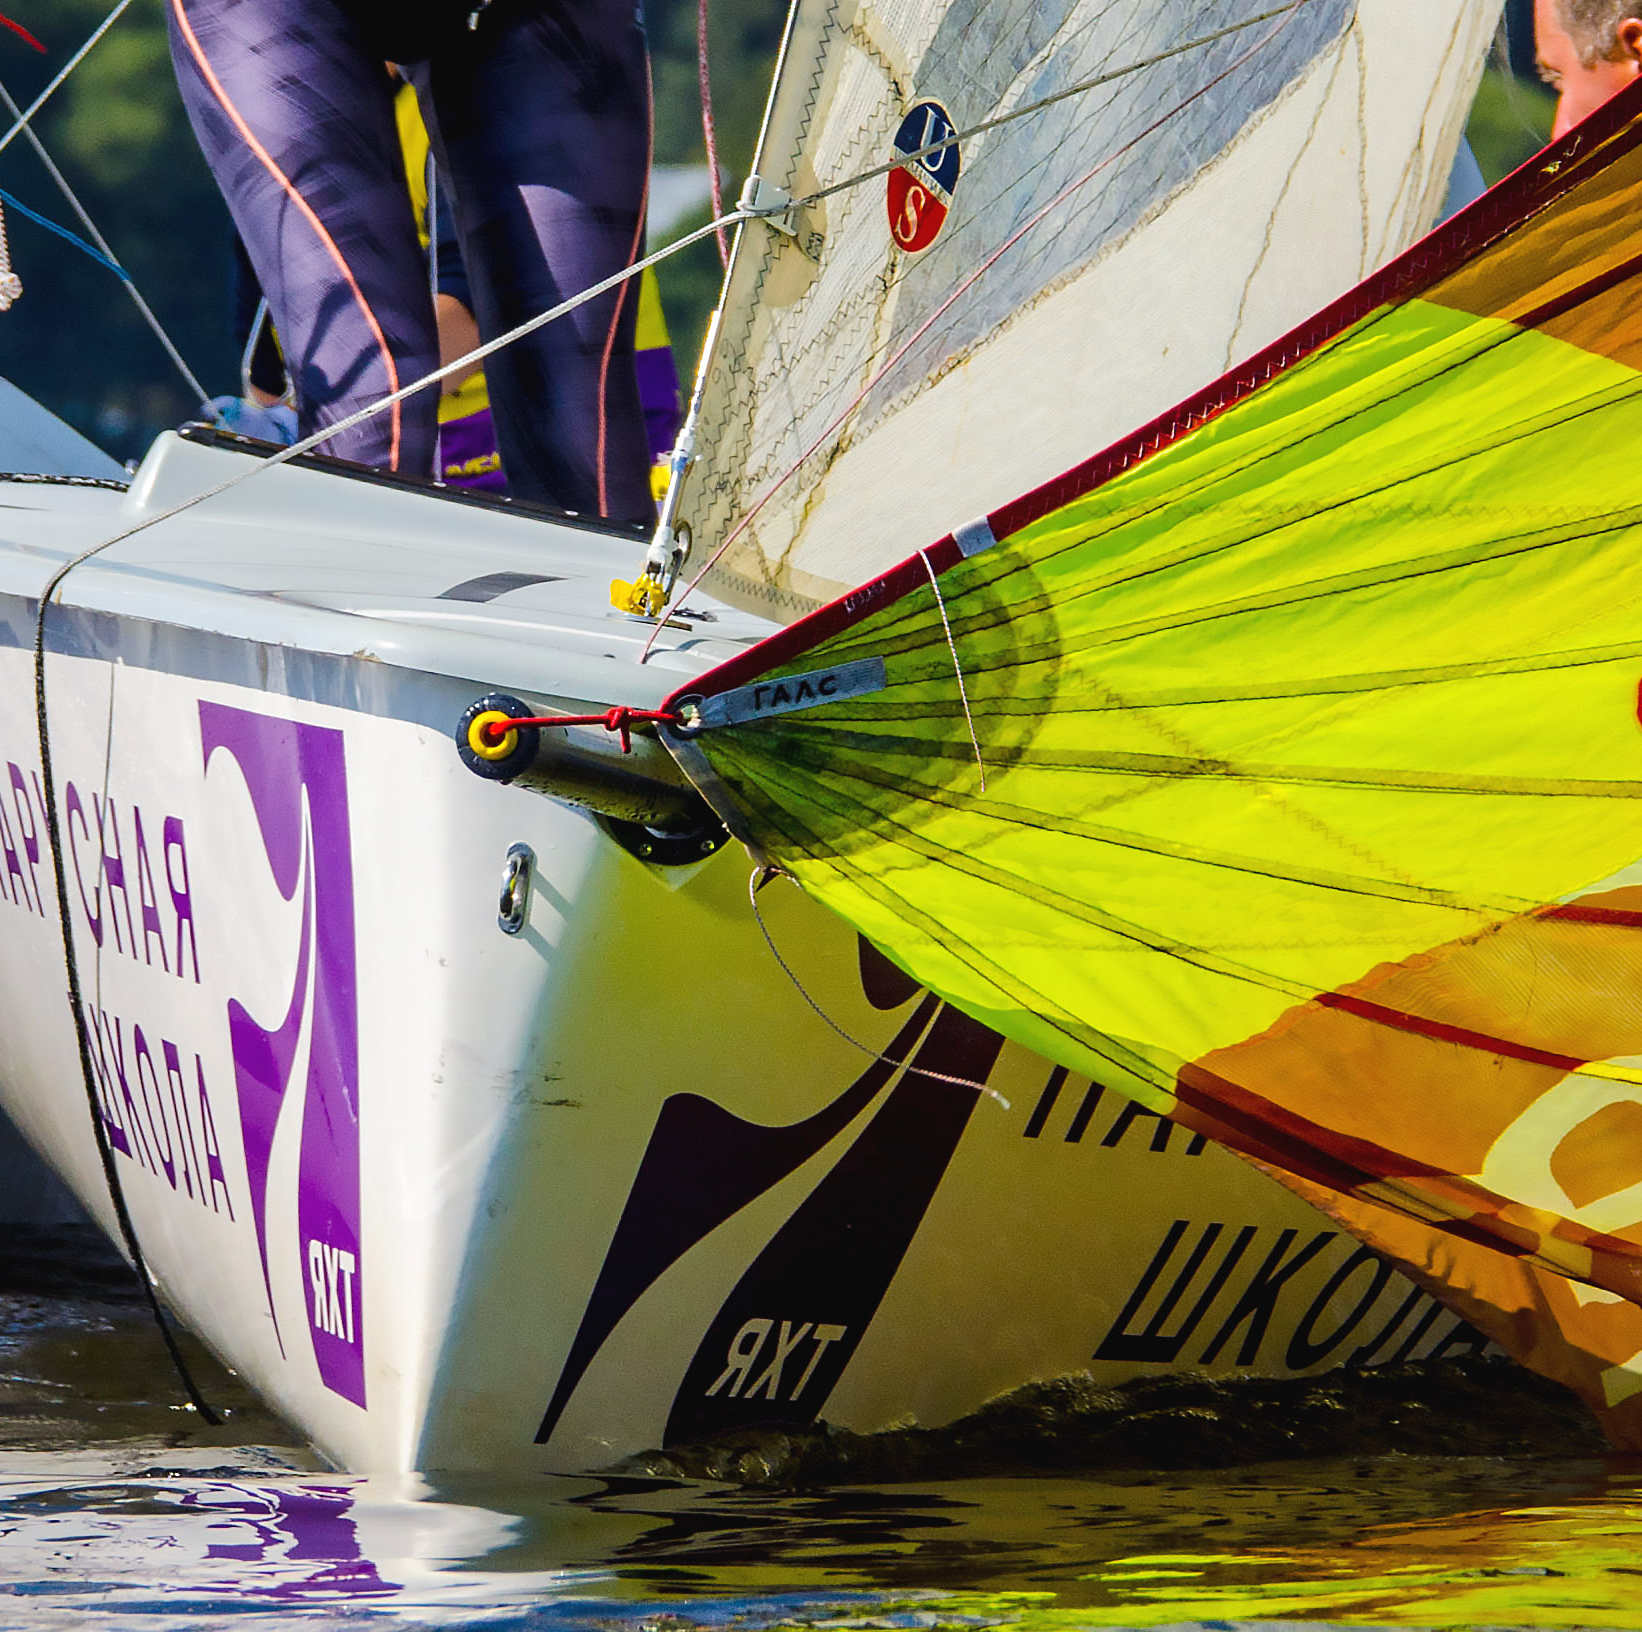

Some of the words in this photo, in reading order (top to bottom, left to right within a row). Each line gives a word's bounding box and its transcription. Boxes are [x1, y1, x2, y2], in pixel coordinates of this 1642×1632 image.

[894, 185, 926, 243] S
[308, 1238, 356, 1344] ЯХТ
[704, 1317, 848, 1402] ЯХТ
